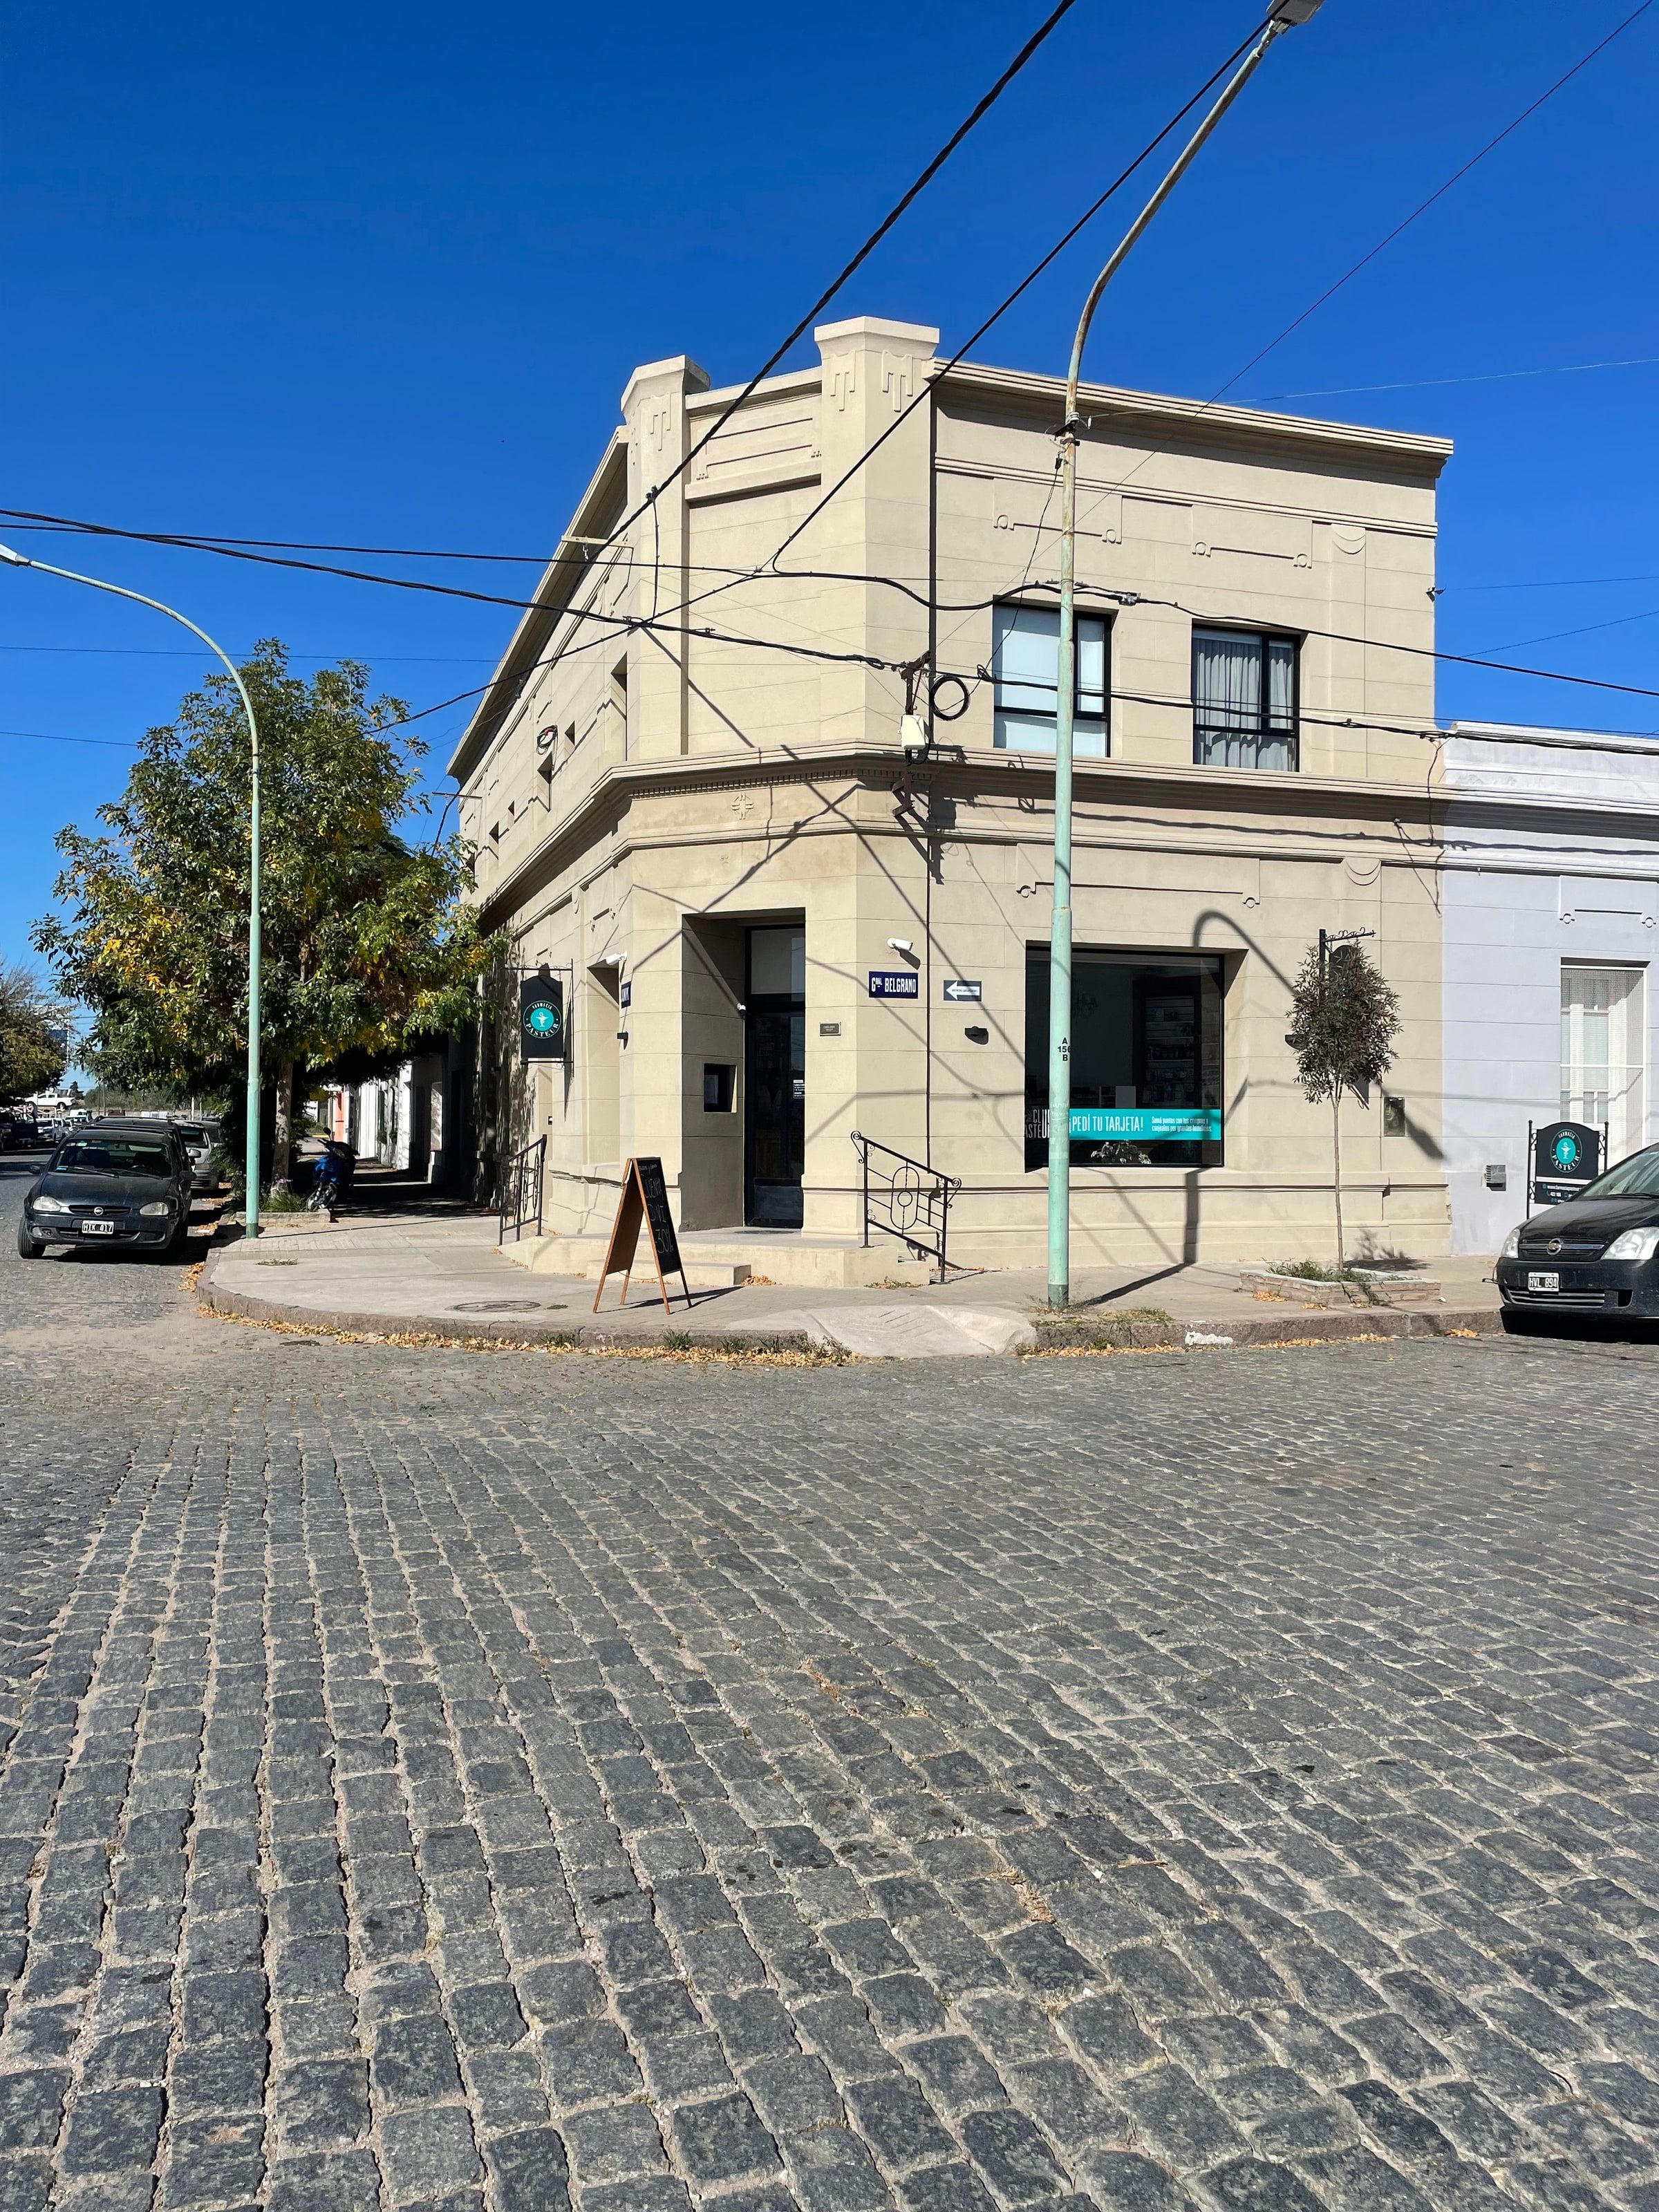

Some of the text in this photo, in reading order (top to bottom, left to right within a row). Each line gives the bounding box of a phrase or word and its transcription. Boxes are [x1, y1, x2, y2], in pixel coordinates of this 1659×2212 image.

[884, 977, 917, 993] BELGRANO
[525, 1023, 559, 1037] PASTEUR
[1069, 1114, 1143, 1134] ¡PEDÍ TU TARJETA!
[1551, 1154, 1580, 1170] PASTEUR
[1529, 1277, 1557, 1288] HVL 894
